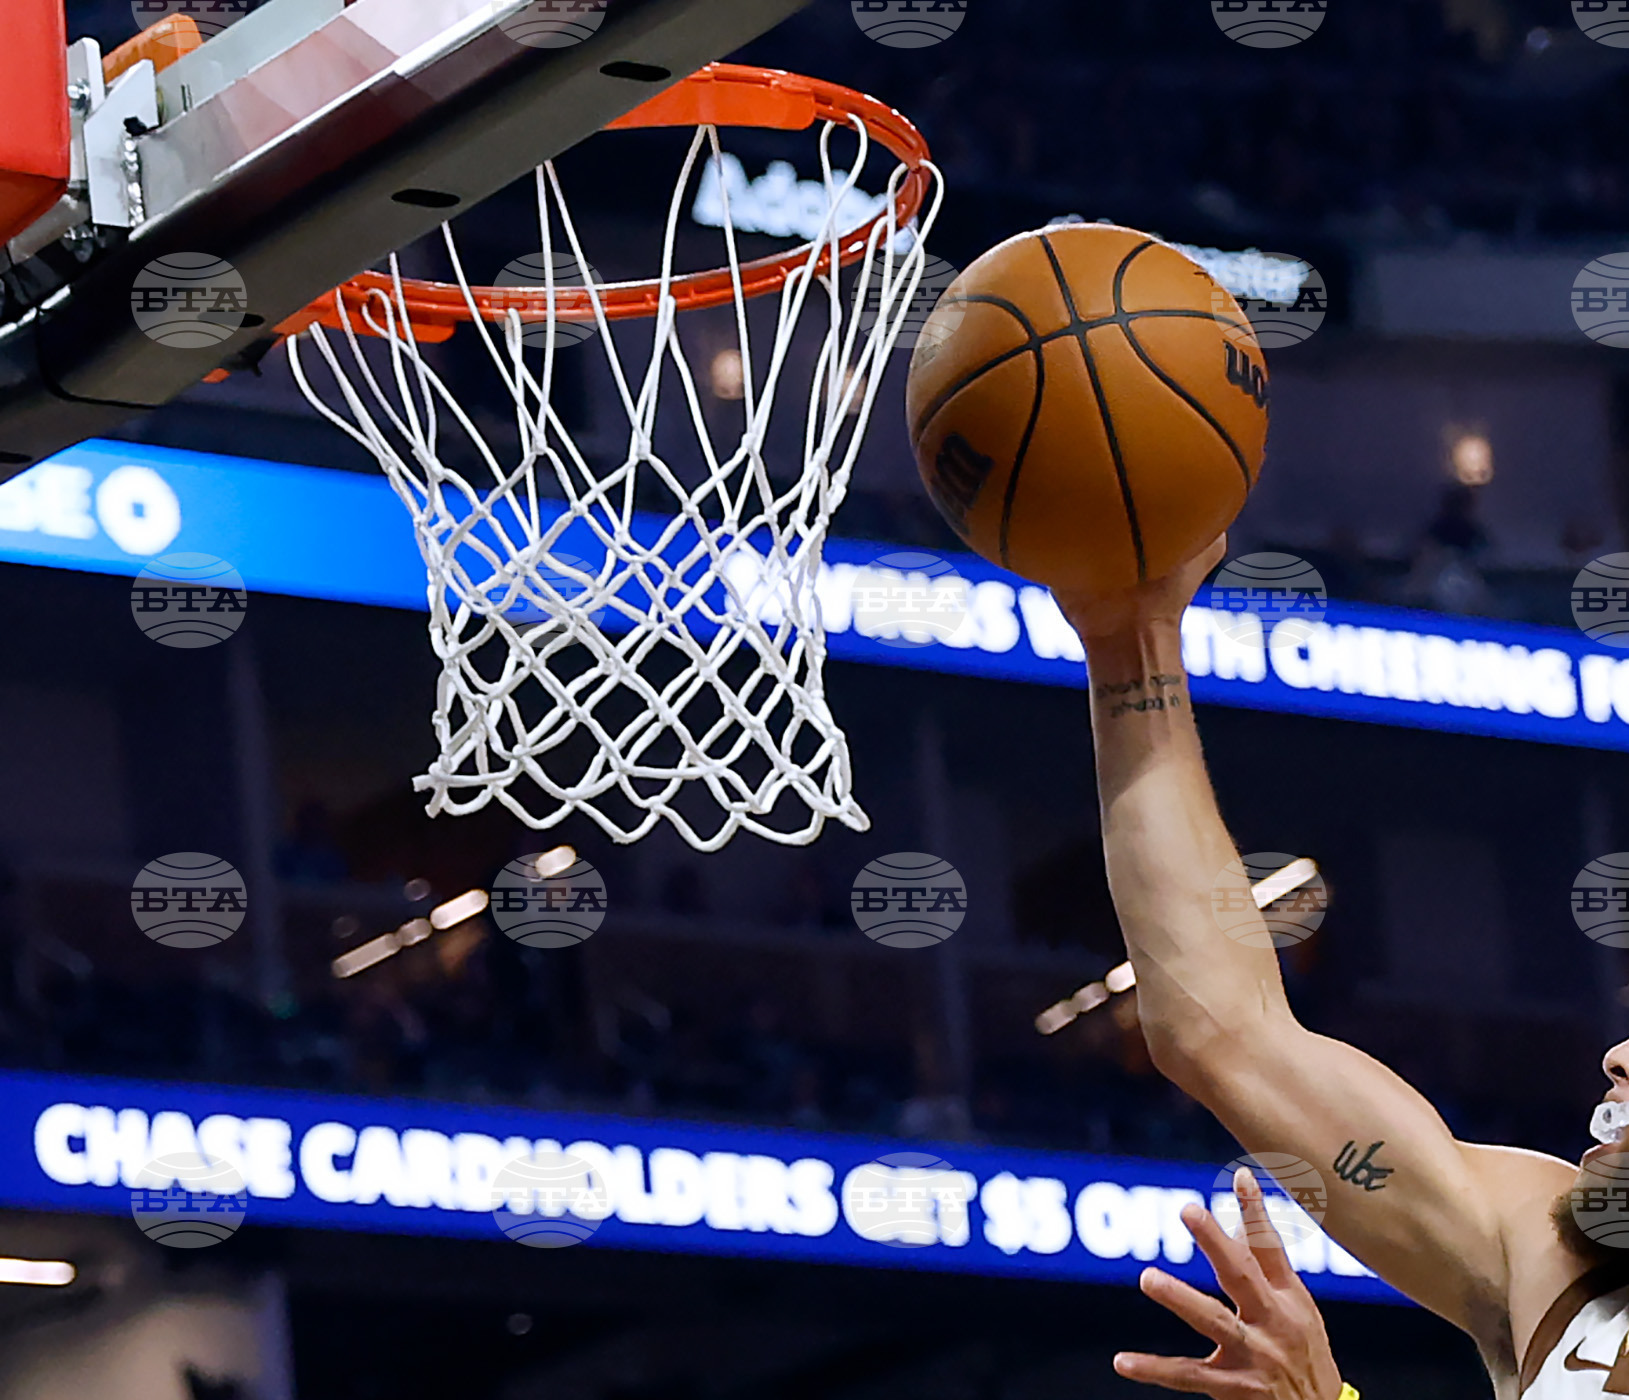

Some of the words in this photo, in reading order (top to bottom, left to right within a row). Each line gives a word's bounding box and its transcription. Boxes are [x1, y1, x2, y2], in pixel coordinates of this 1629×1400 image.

[34, 1103, 295, 1199] CHASE
[300, 1121, 838, 1237] CARDHOLDERS
[841, 1163, 979, 1248] GET
